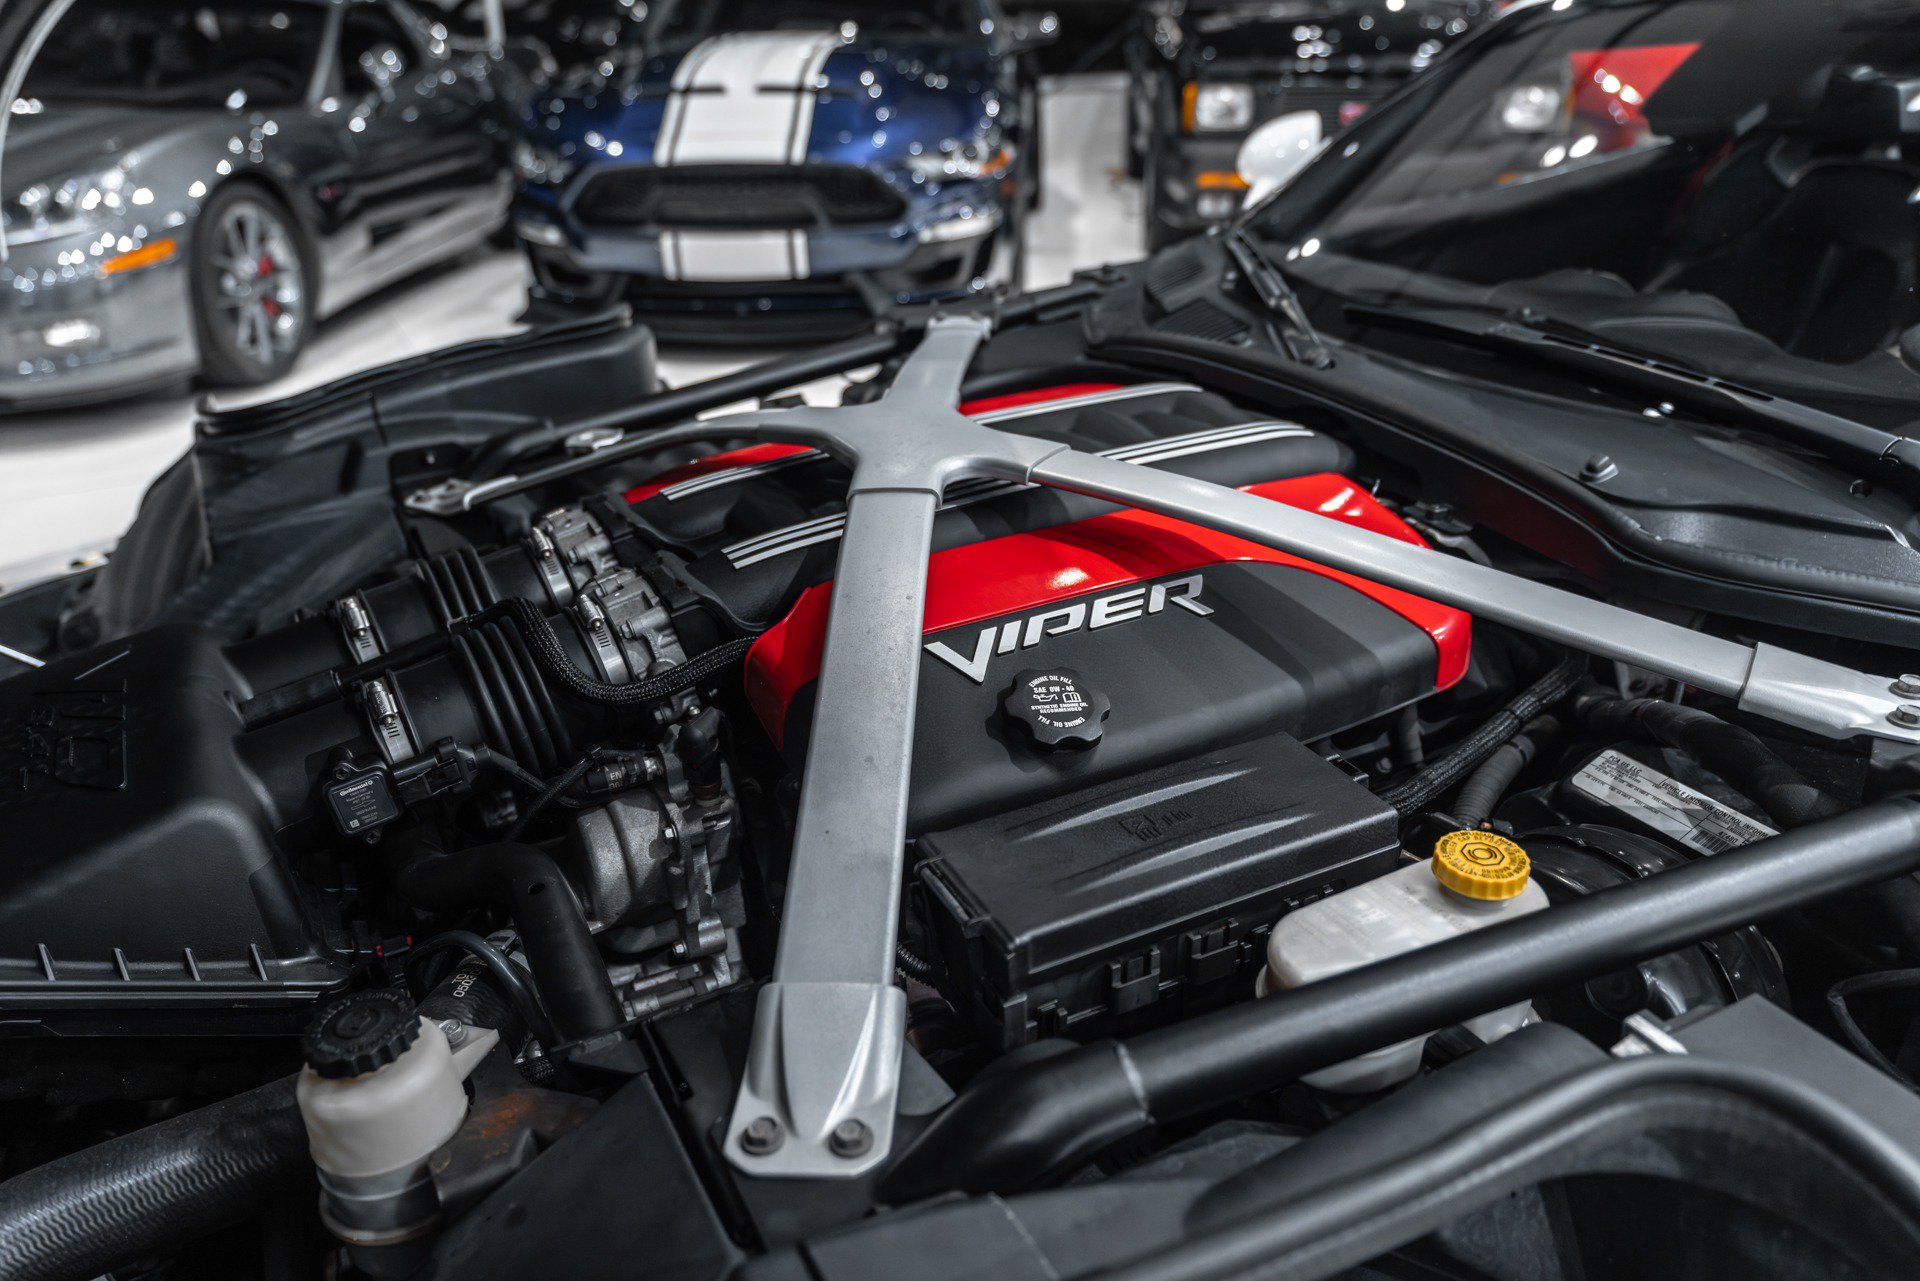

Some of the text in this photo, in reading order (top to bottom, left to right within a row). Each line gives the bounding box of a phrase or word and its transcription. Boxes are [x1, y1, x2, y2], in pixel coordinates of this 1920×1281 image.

[924, 574, 1215, 684] VIPER
[1028, 675, 1049, 688] ENGINE
[1060, 676, 1072, 685] FILL
[1040, 706, 1082, 714] RECOMMENDED
[1037, 714, 1051, 725] FILL
[1063, 716, 1086, 728] ENGINE
[1661, 781, 1686, 797] VEHICLE
[1685, 793, 1715, 812] EMISSION
[1714, 807, 1742, 825] CONTROL
